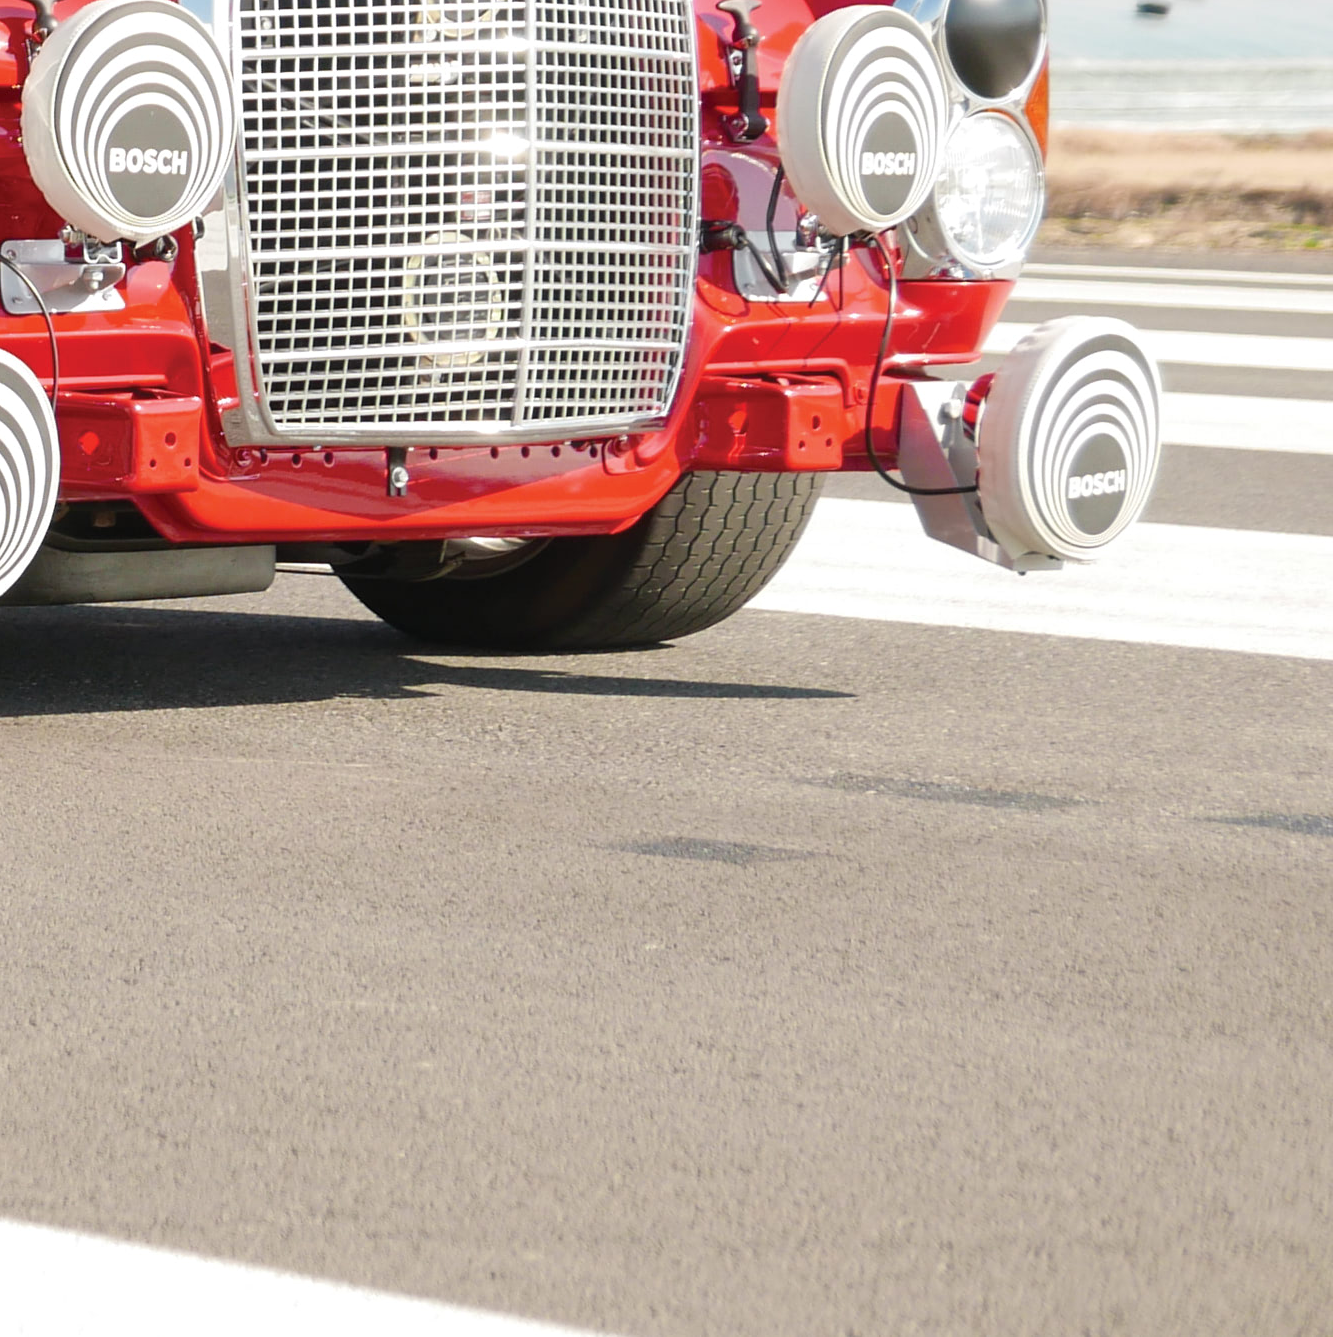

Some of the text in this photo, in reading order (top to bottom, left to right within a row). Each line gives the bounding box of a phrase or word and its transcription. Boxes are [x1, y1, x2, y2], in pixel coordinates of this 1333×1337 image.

[109, 147, 188, 175] BOSCH
[861, 151, 916, 176] BOSCH
[1067, 469, 1126, 499] BOSCH
